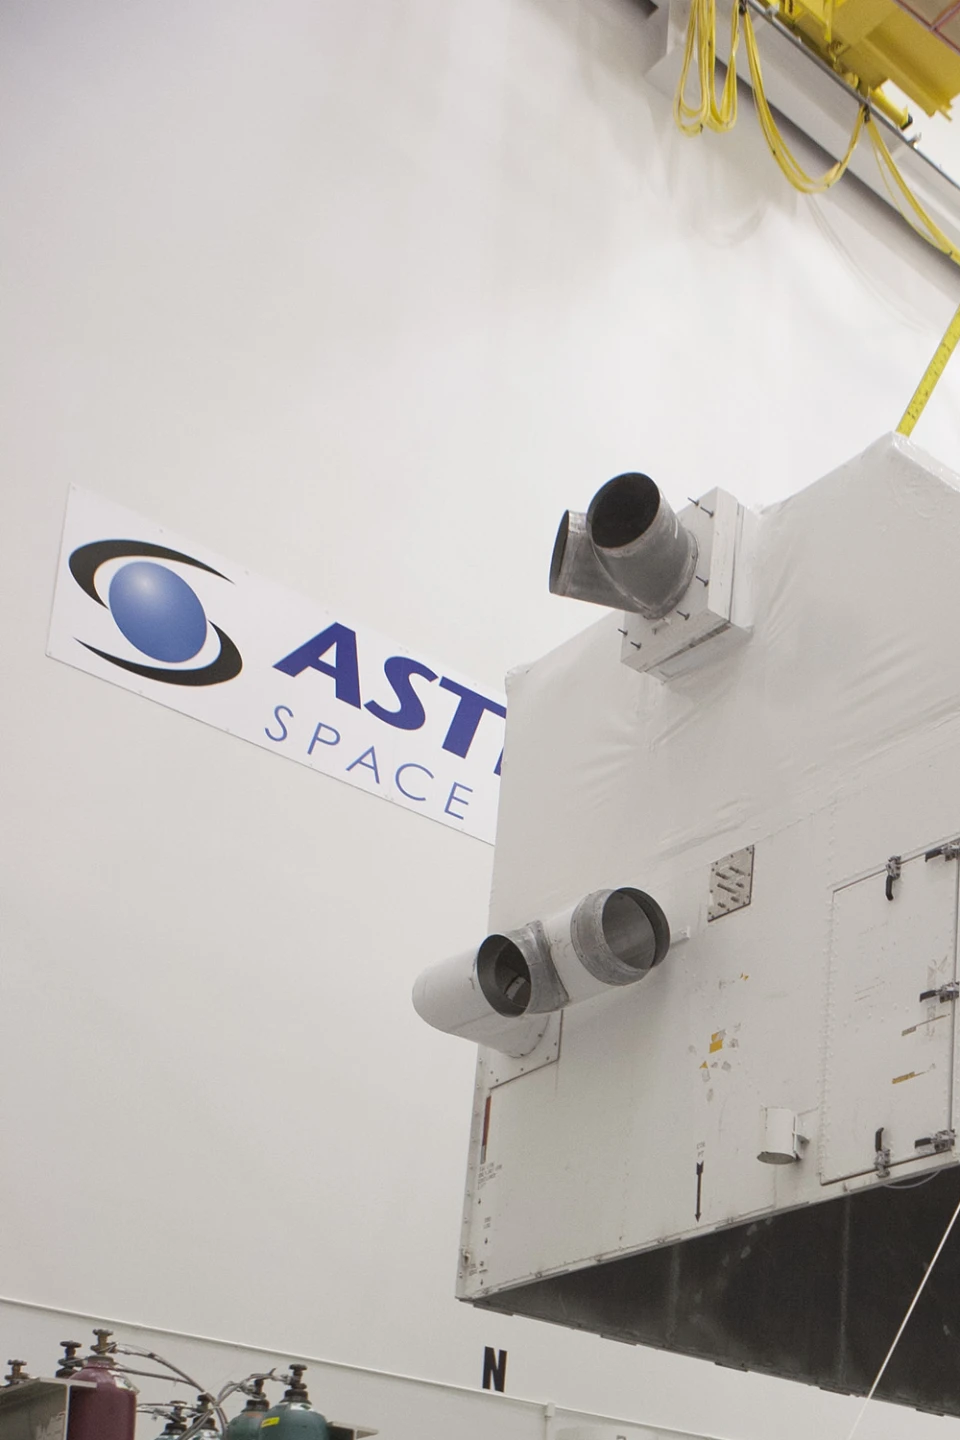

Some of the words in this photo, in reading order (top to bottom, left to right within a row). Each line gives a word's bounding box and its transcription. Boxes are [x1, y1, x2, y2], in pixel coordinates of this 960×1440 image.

[272, 621, 507, 776] AST
[265, 705, 474, 820] SPACE
[482, 1346, 508, 1393] N
